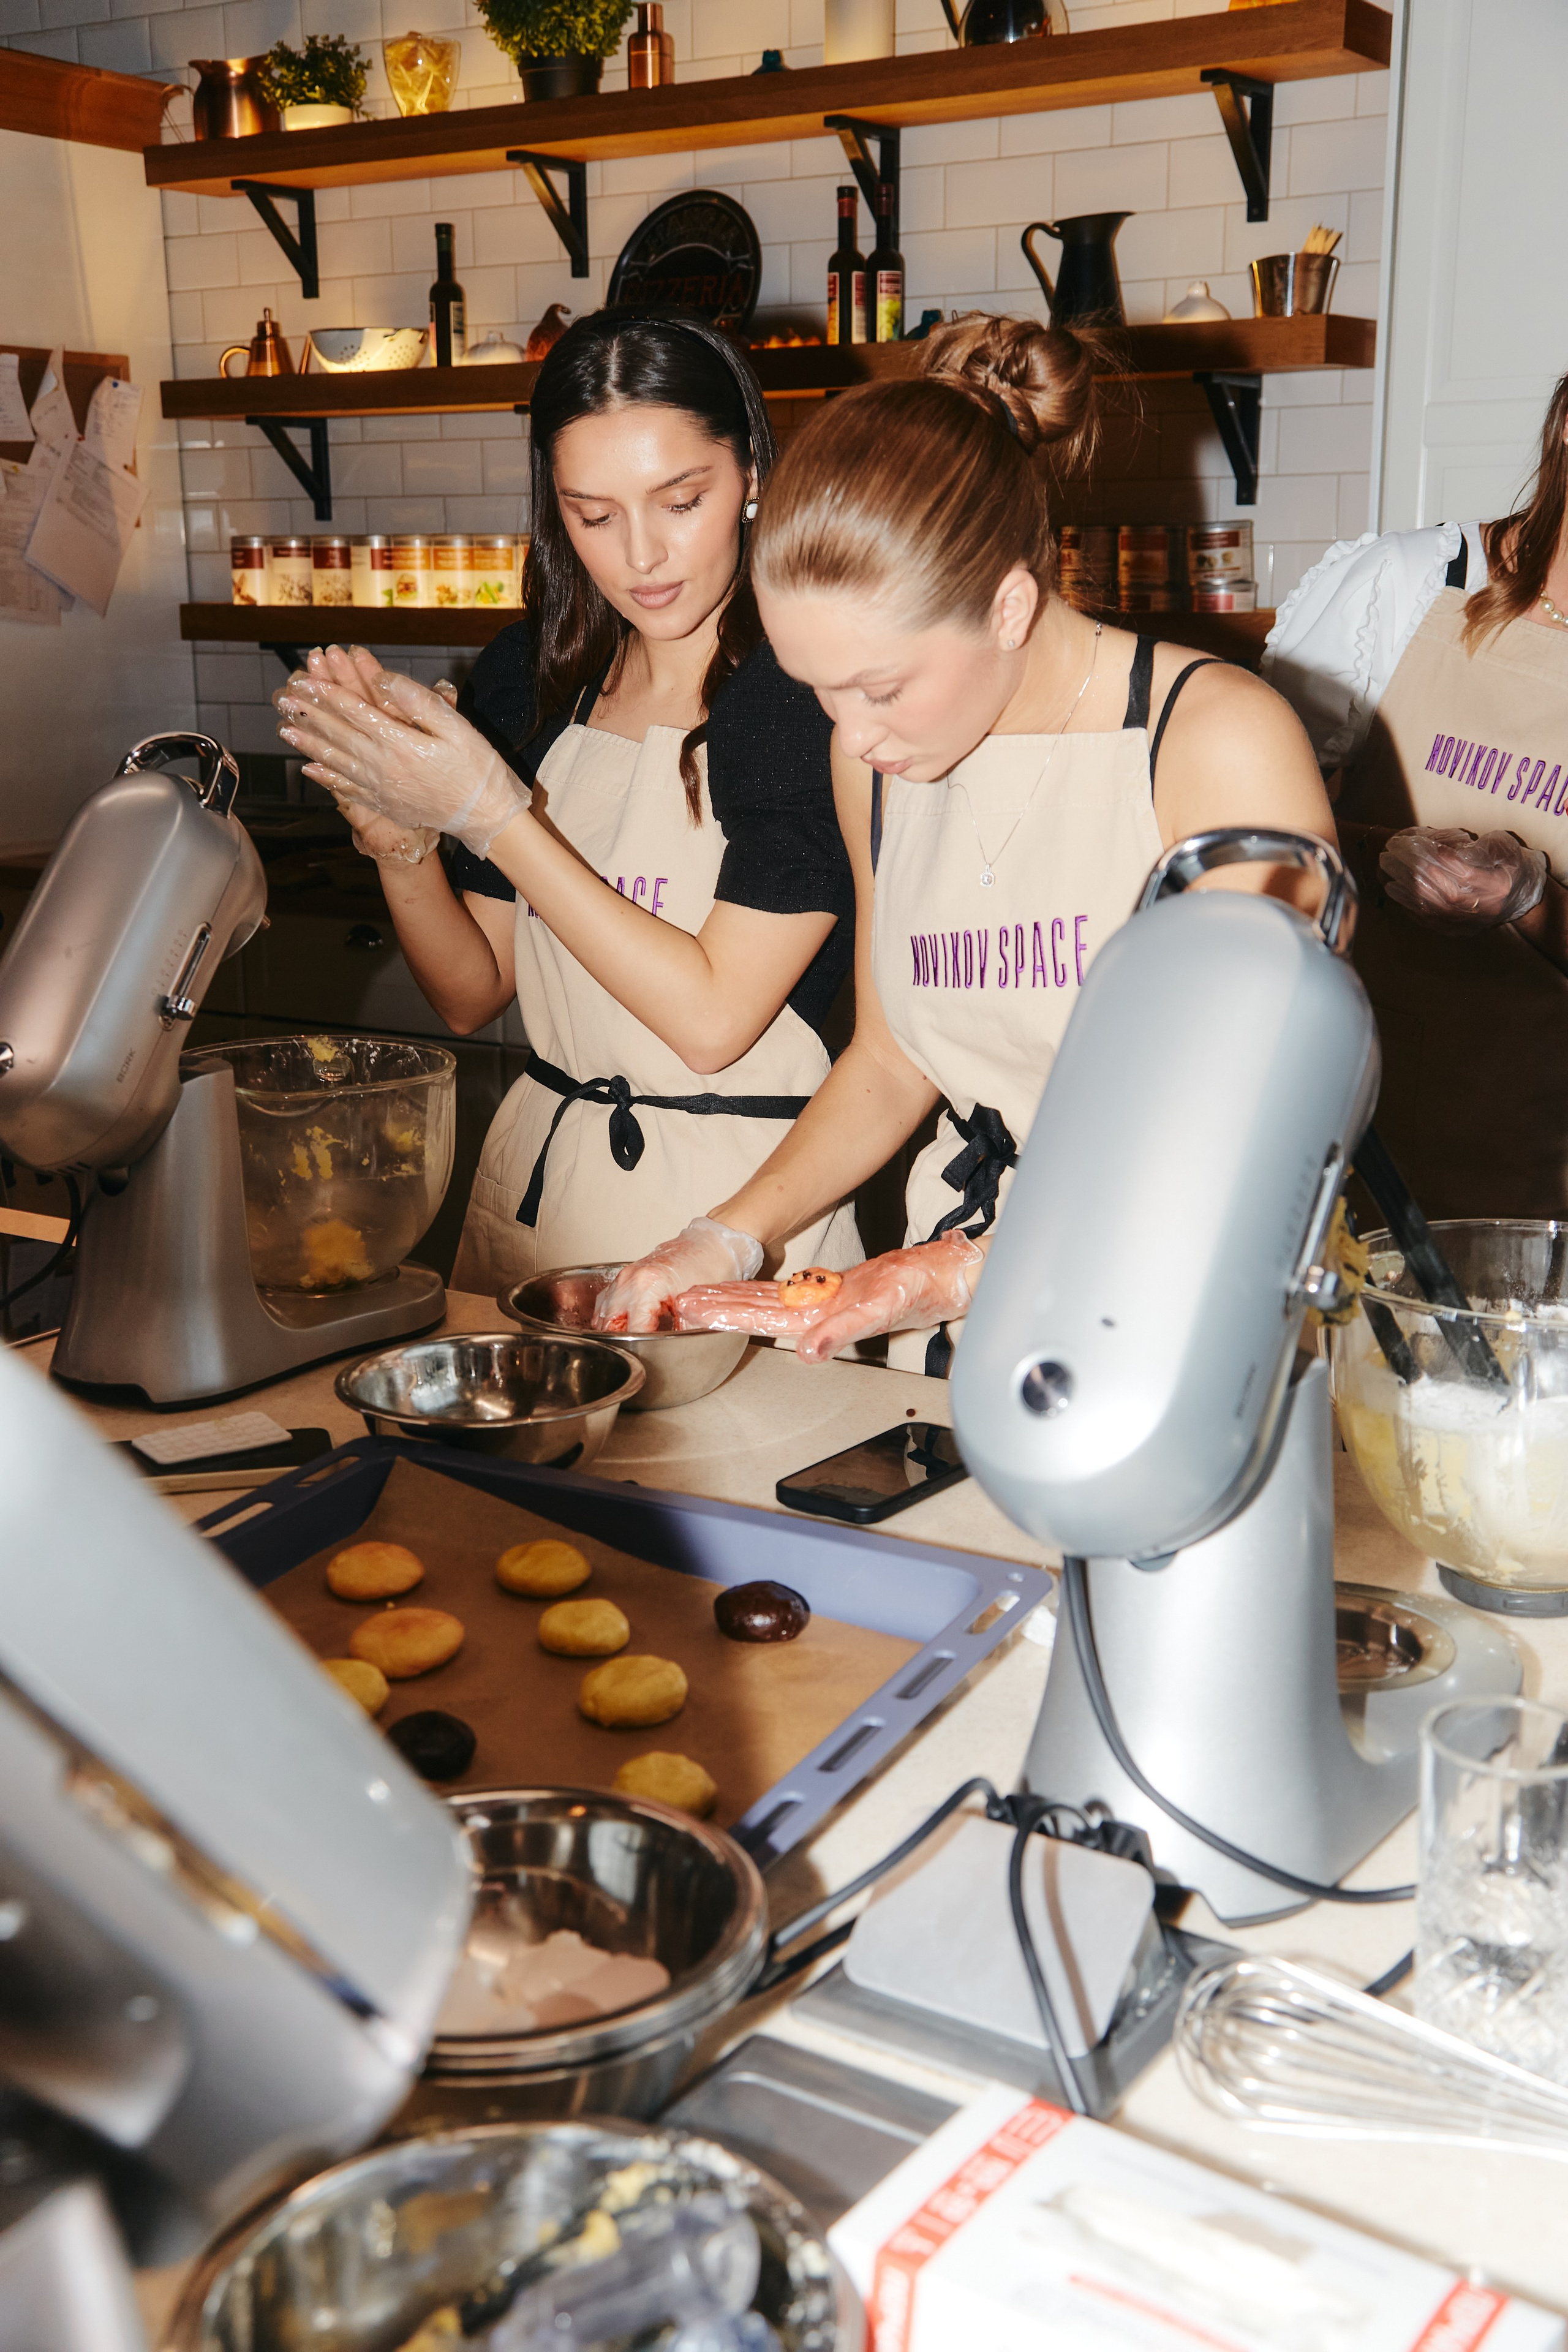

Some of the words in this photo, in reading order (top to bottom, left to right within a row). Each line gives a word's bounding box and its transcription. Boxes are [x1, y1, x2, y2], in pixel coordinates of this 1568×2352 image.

[622, 273, 745, 307] PIZZERIA
[1425, 734, 1513, 794] NOVIKOV
[910, 929, 988, 989] NOVIKOV
[998, 914, 1088, 989] SPACE
